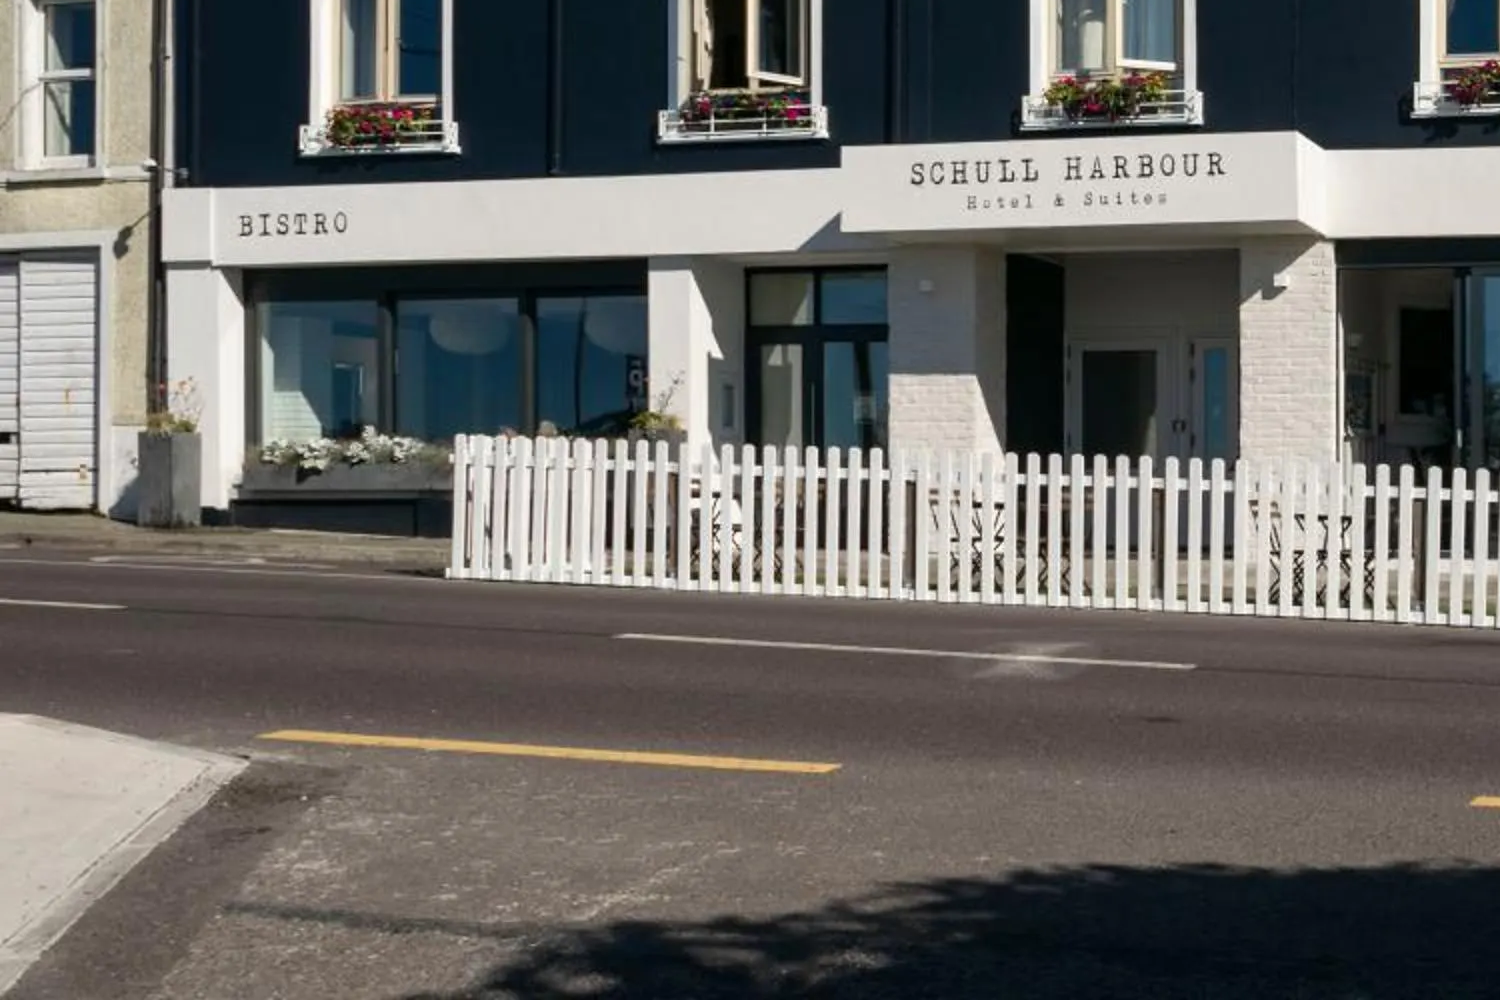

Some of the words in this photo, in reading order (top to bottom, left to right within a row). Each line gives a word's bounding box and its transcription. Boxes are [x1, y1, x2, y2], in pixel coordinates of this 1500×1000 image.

[910, 158, 1040, 186] SCHULL
[1063, 152, 1227, 181] HARBOUR
[966, 194, 1034, 210] Hotel
[1053, 193, 1065, 207] &
[1083, 191, 1168, 206] Suites
[238, 211, 348, 237] BISTRO
